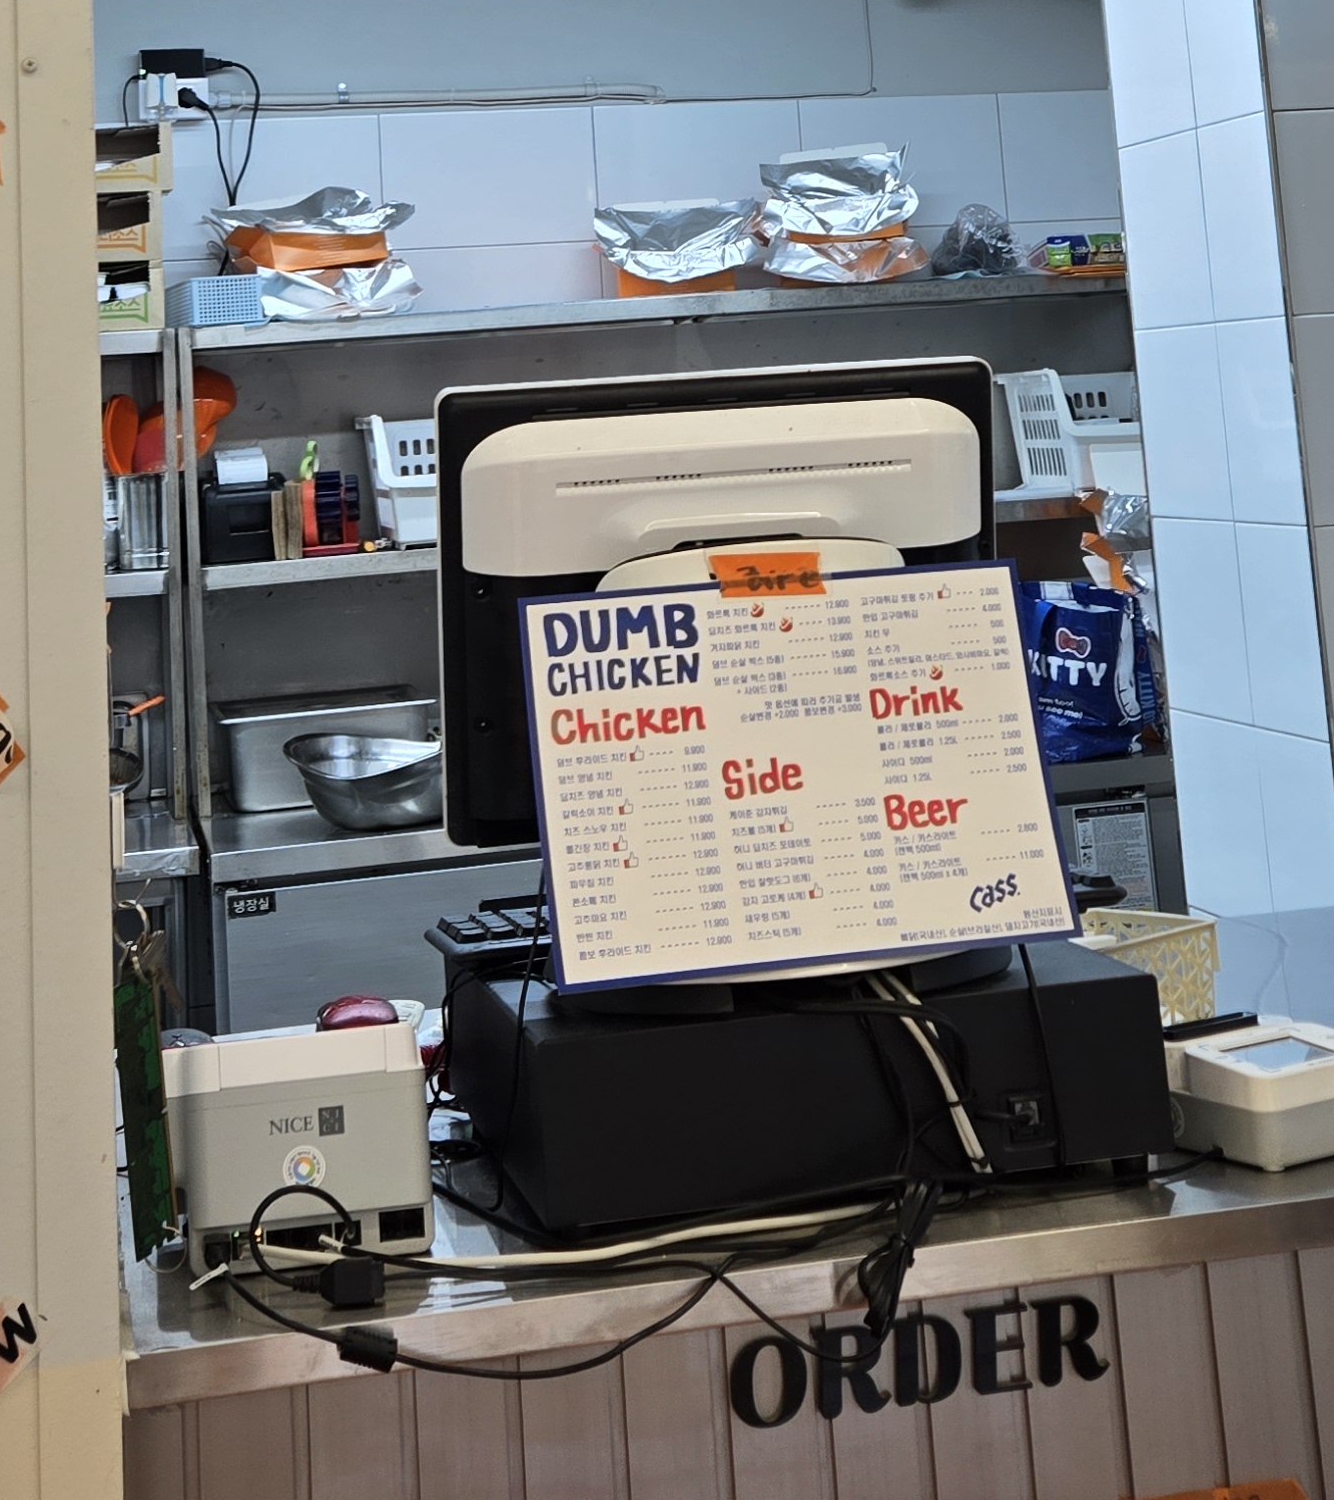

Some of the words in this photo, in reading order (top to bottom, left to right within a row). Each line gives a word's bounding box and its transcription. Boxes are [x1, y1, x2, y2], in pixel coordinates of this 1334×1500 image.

[543, 602, 700, 658] DUMB
[547, 652, 700, 697] CHICKEN
[1028, 648, 1108, 687] KITTY
[868, 684, 965, 720] Drink
[550, 703, 707, 746] Chicken
[720, 757, 804, 801] Side
[882, 793, 969, 831] Beer
[233, 896, 270, 914] 냉장실
[269, 1114, 314, 1136] NICE
[729, 1294, 1111, 1430] ORDER
